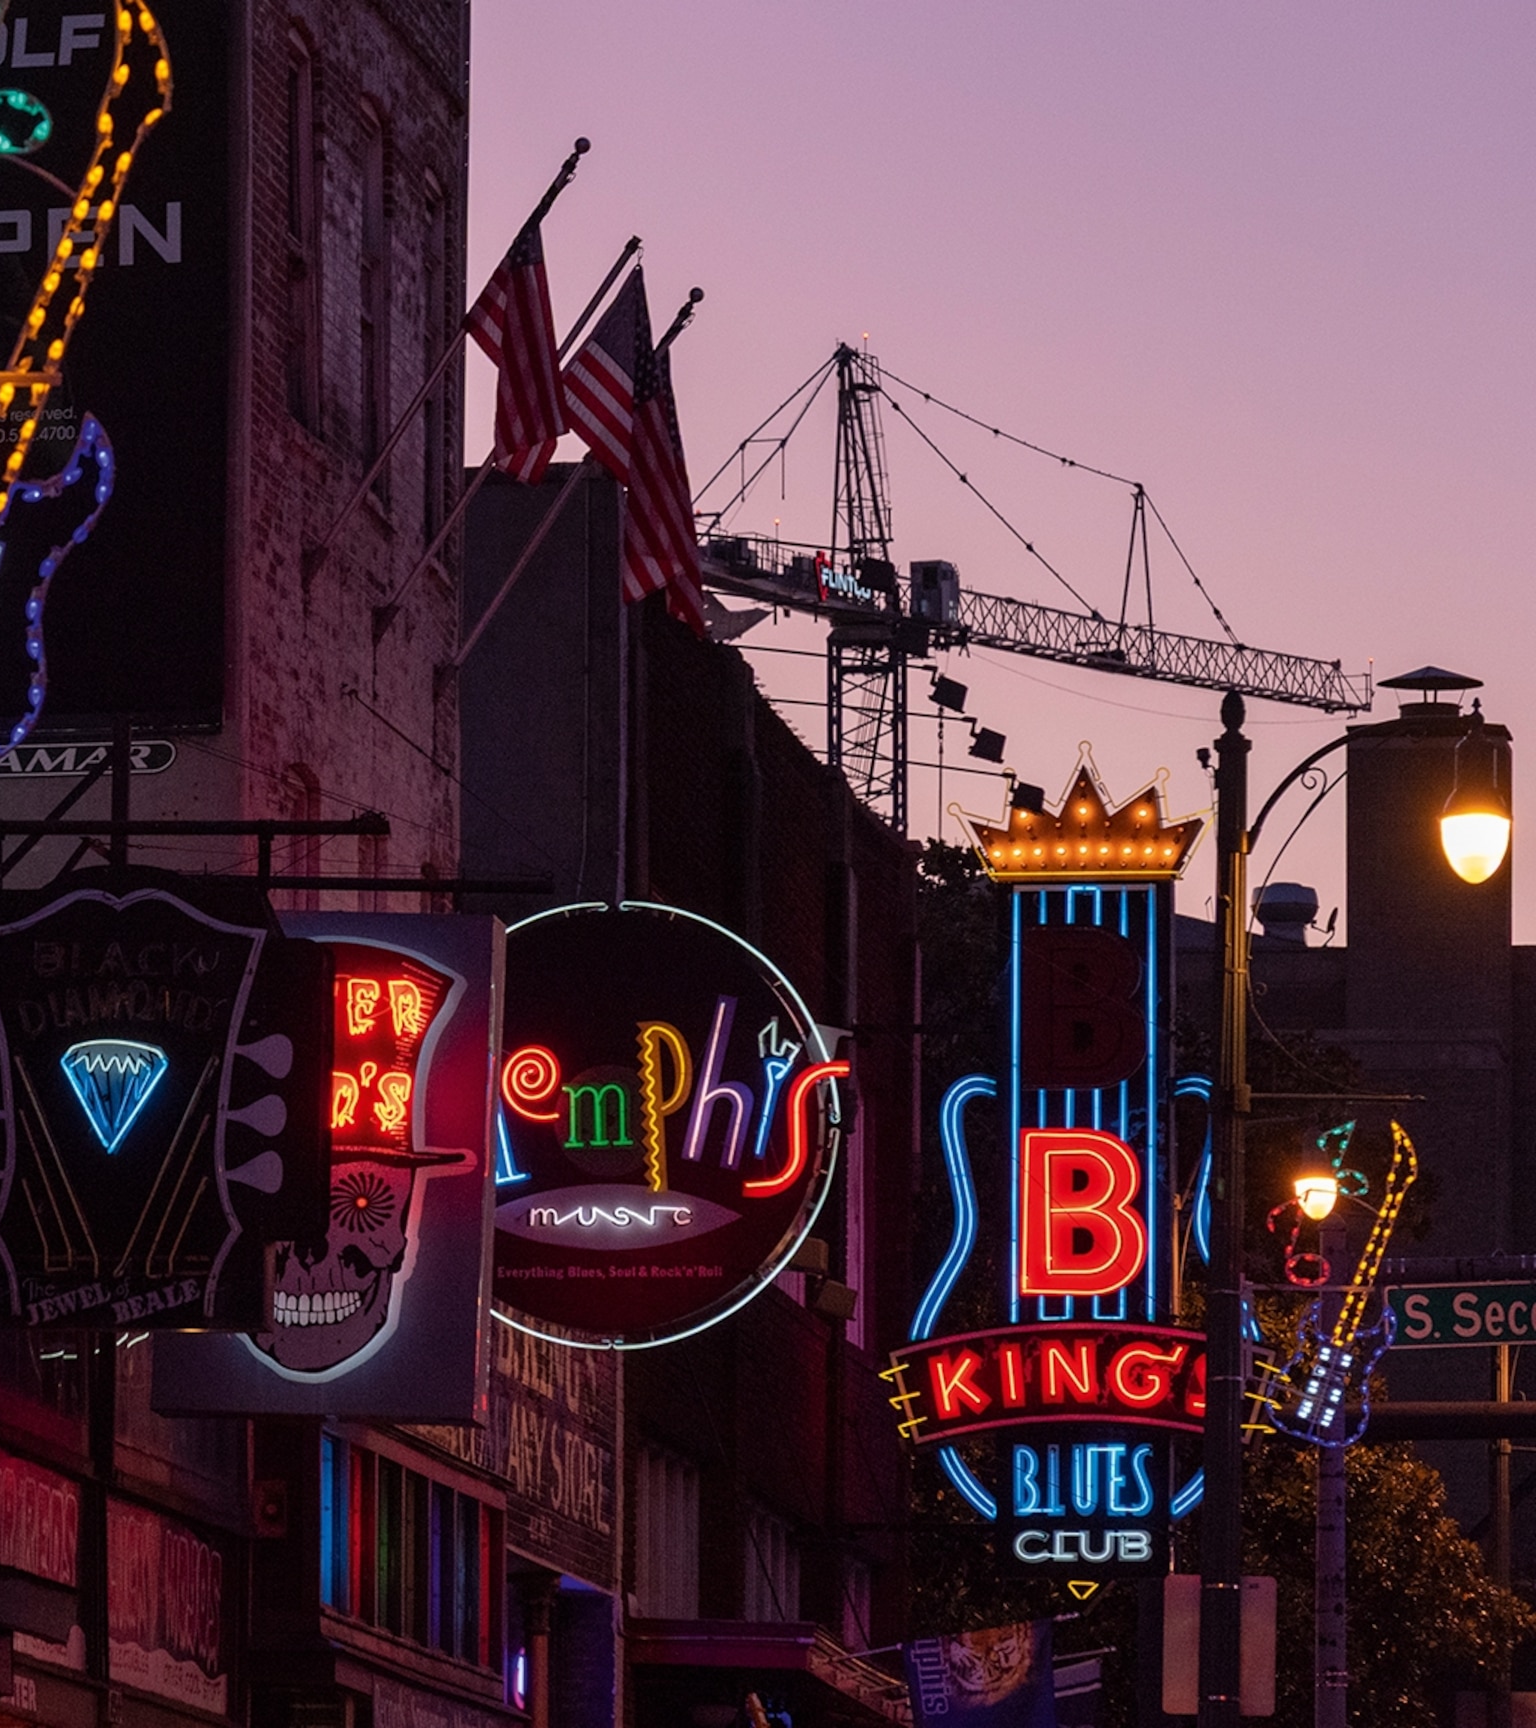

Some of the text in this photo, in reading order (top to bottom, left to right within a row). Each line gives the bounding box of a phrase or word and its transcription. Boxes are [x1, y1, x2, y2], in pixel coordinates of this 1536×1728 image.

[10, 406, 78, 423] resrved.
[528, 1205, 693, 1227] music
[1019, 1126, 1149, 1297] B
[496, 1265, 565, 1280] Everything
[567, 1264, 606, 1280] Blues,
[608, 1265, 637, 1278] Soul
[638, 1265, 649, 1278] &
[25, 1282, 112, 1327] JEWEL
[112, 1277, 202, 1325] BEALE
[1404, 1291, 1536, 1340] S. Sec
[1011, 1441, 1155, 1518] BLUES
[1013, 1528, 1154, 1564] CLUB
